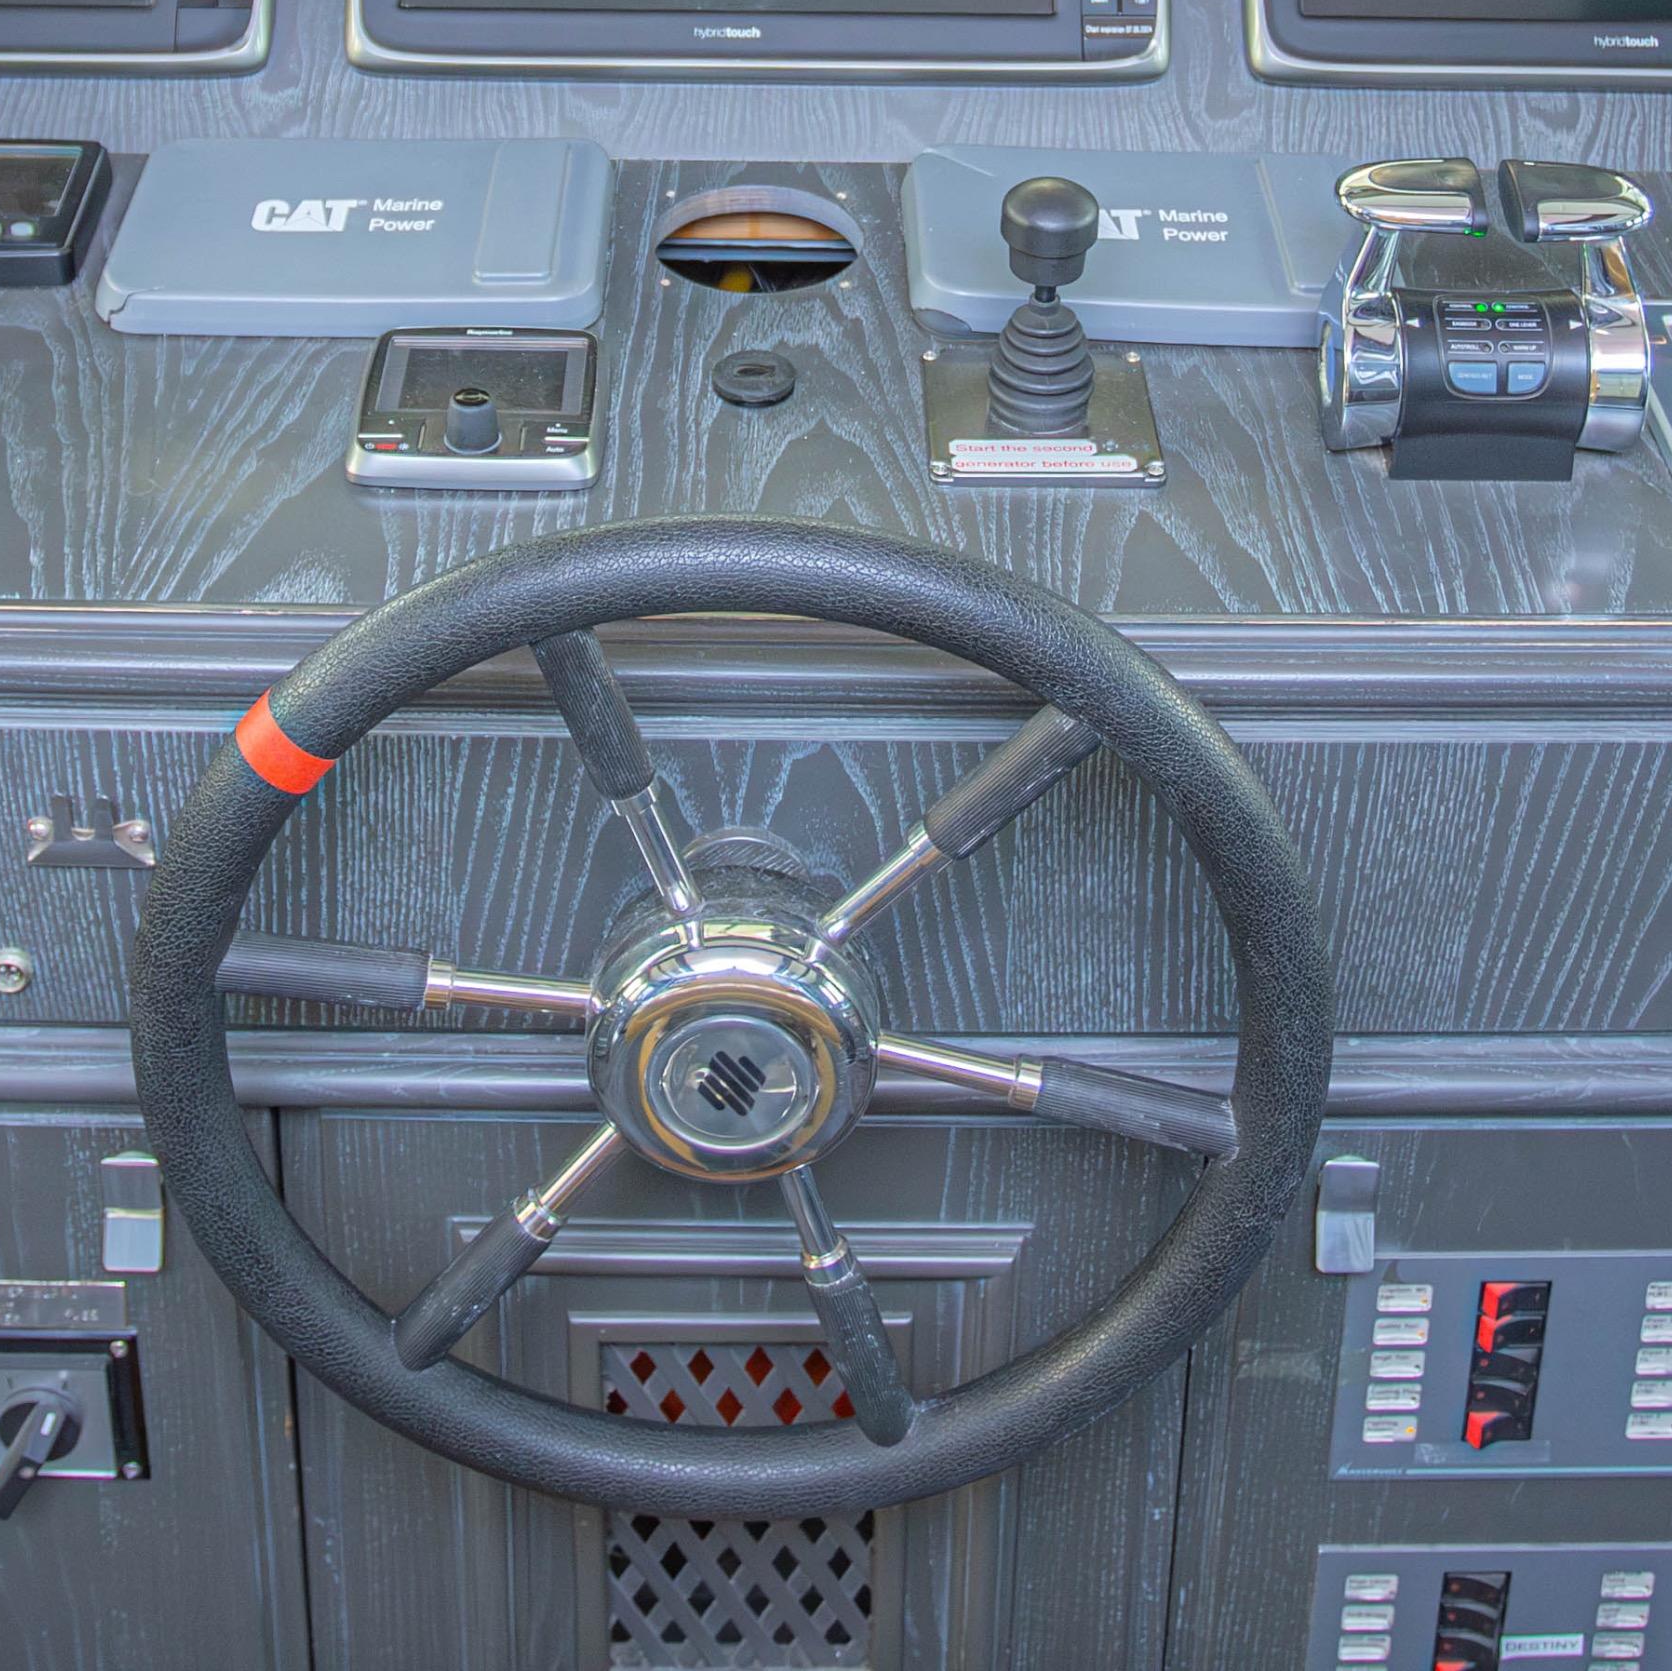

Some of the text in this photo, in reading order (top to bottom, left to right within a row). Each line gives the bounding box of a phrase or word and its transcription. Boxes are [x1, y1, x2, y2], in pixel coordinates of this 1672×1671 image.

[693, 26, 761, 40] hybridtouch
[1593, 34, 1659, 48] hybridtouch
[251, 198, 444, 232] CAT Marine
[368, 218, 435, 232] Power
[1097, 209, 1229, 240] AT Marine
[1162, 227, 1229, 242] Power
[955, 442, 1094, 453] Start the second
[954, 459, 1132, 470] generator before use
[1504, 1637, 1579, 1654] DESTINY
